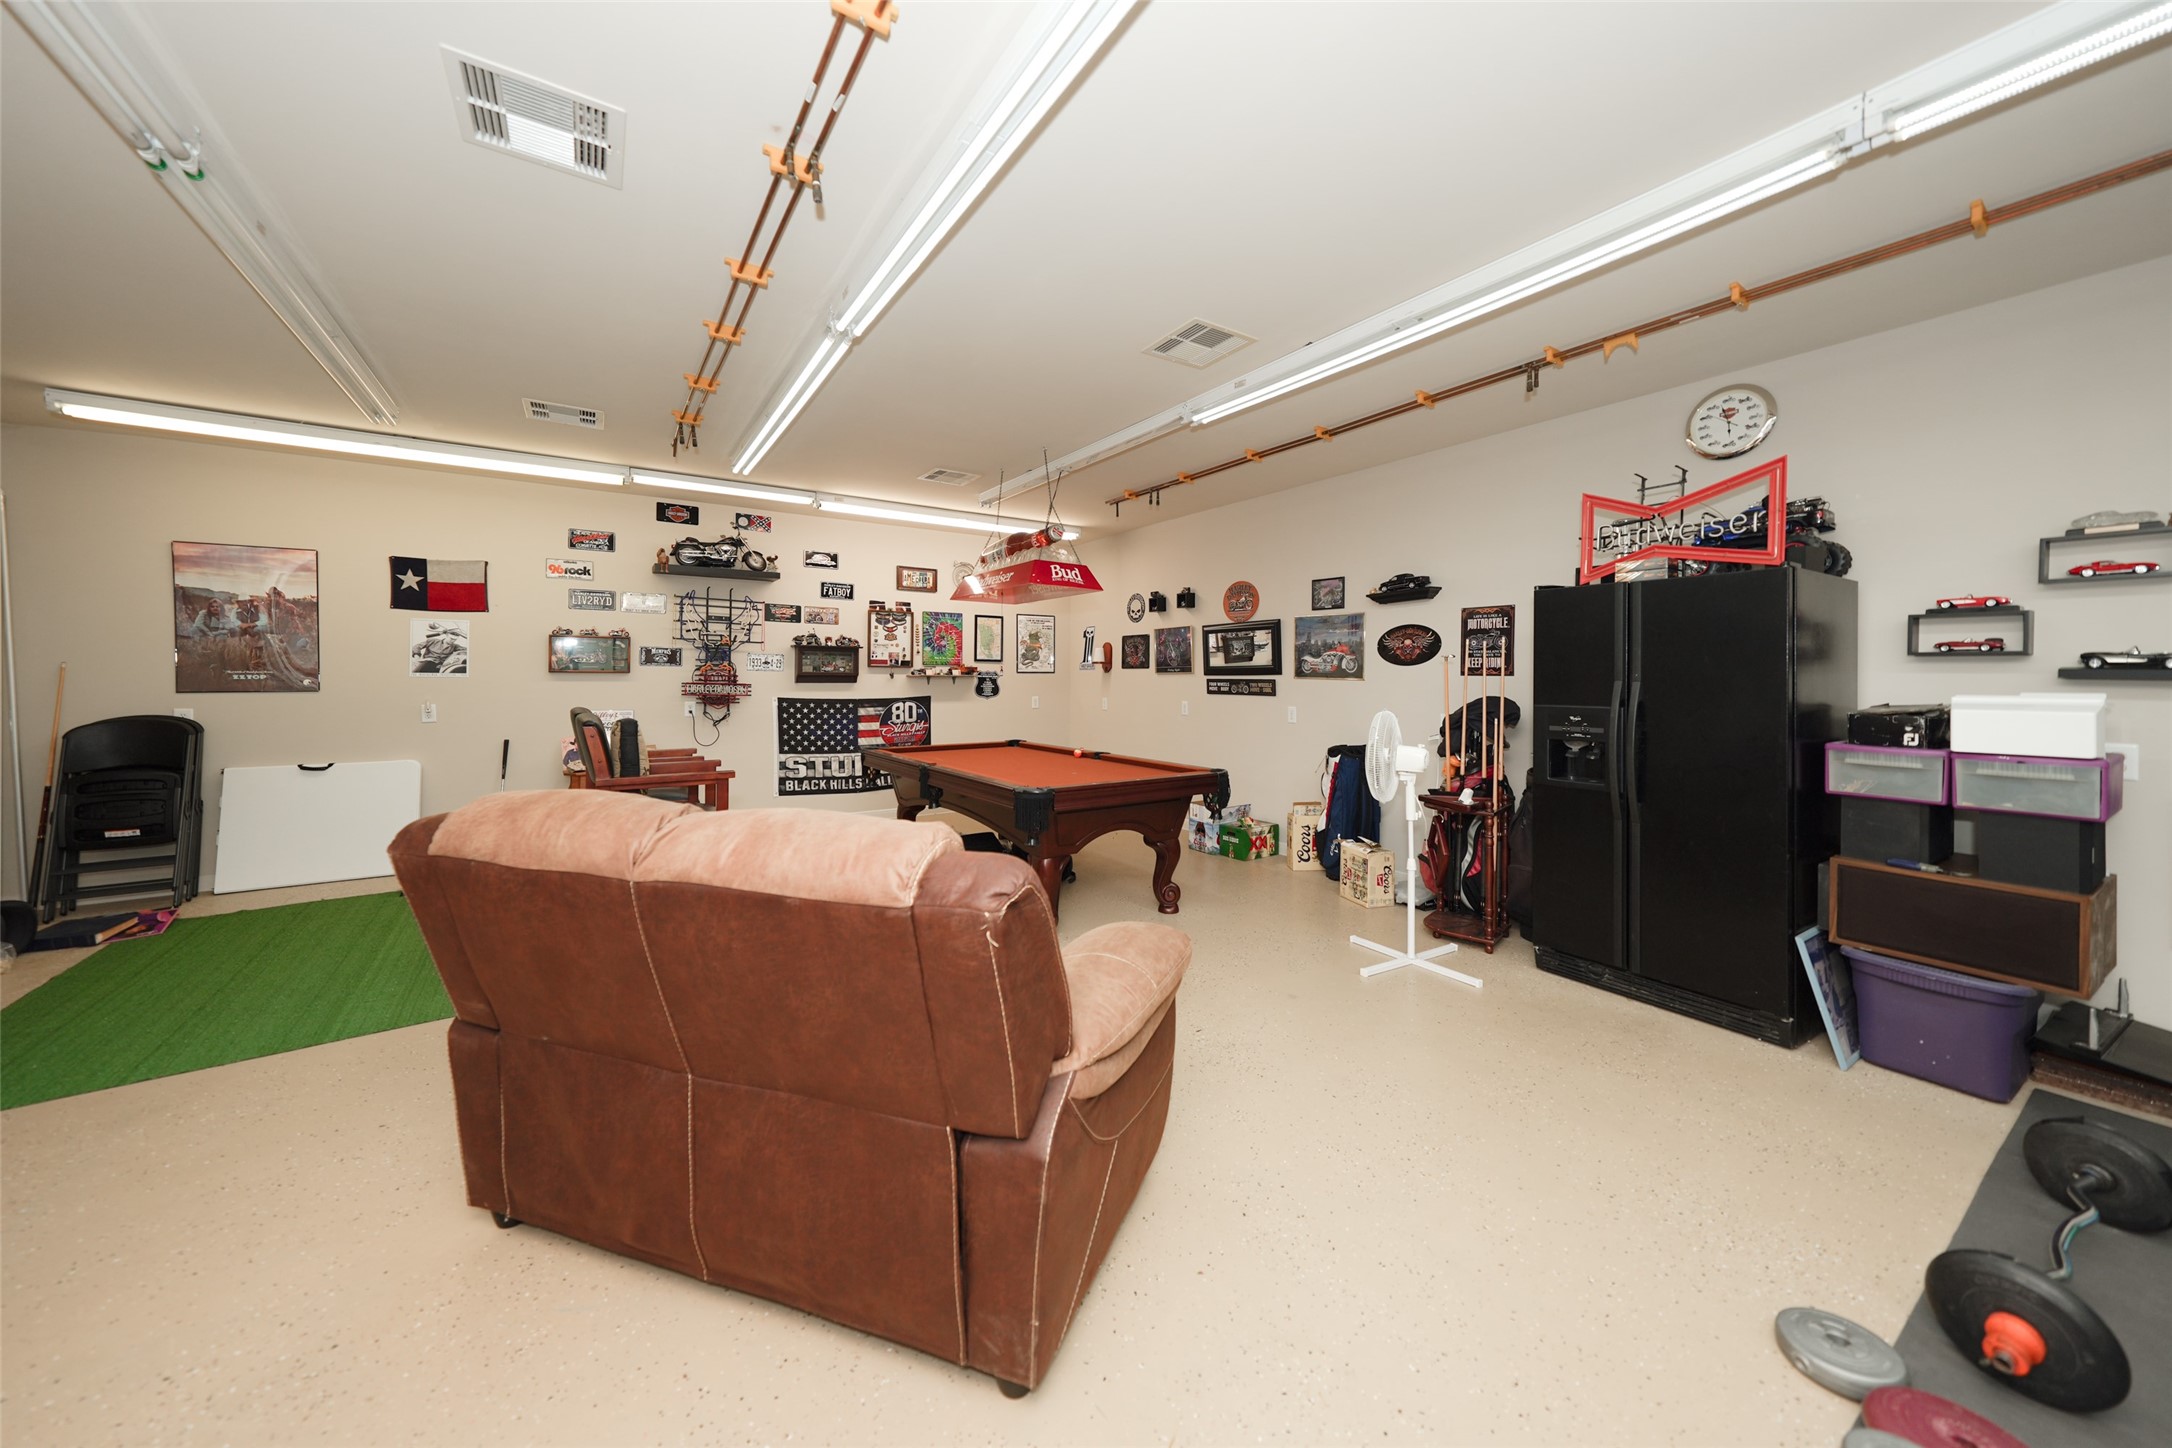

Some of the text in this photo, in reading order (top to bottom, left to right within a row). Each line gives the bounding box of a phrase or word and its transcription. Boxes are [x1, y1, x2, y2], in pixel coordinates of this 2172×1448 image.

[1596, 509, 1767, 552] Budweiser
[1050, 564, 1083, 582] Bud
[572, 595, 613, 606] LIV2RYD
[824, 586, 851, 597] FATBOY
[891, 701, 917, 723] 80
[1903, 733, 1920, 746] FJ
[785, 779, 828, 792] BLACK
[829, 778, 863, 790] HILLS
[1297, 824, 1312, 864] Coors
[1383, 864, 1393, 895] Coors
